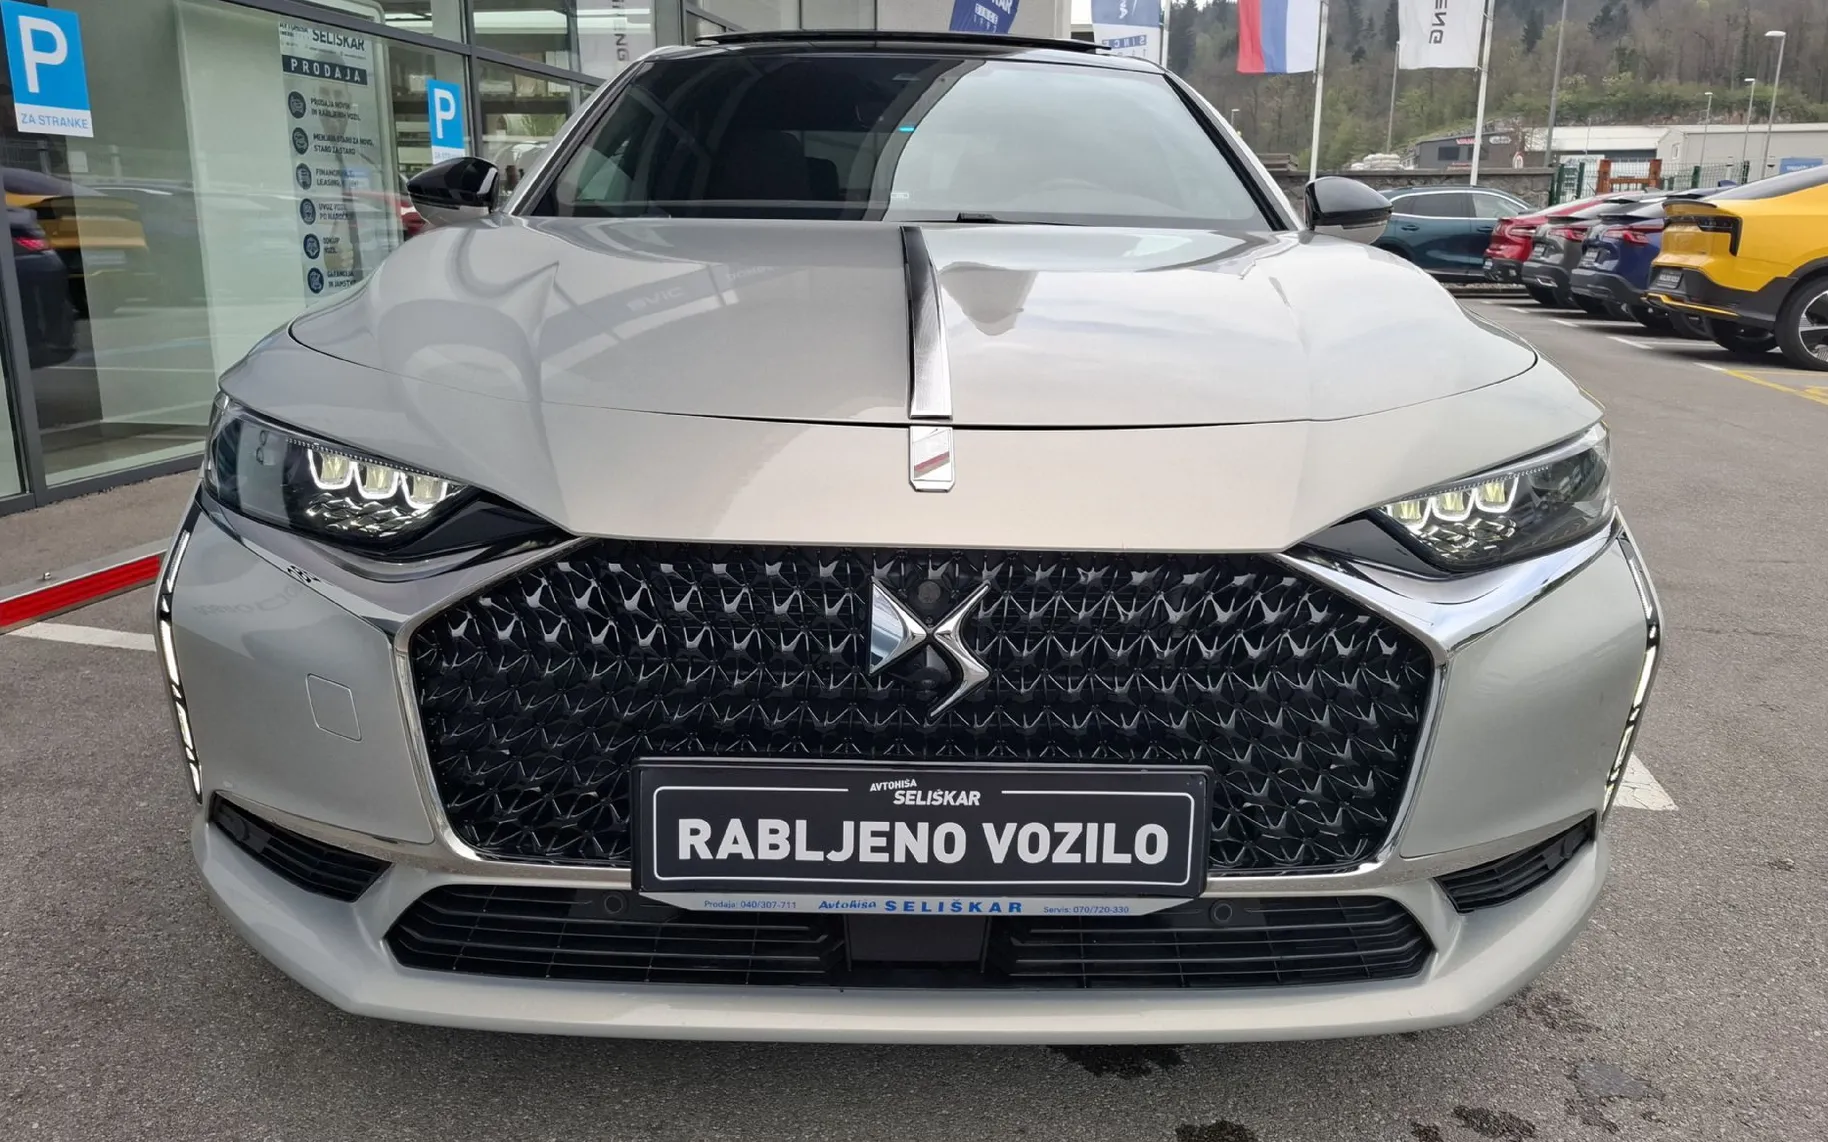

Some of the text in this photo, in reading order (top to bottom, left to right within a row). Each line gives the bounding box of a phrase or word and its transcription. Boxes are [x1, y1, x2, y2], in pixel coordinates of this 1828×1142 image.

[18, 15, 68, 93] P
[290, 58, 361, 83] PRODAJA
[21, 113, 88, 128] ZA STRANKE
[434, 88, 456, 139] P
[869, 779, 918, 792] AVTOHIŠA
[893, 788, 981, 806] SELIŠKAR
[678, 818, 1170, 865] RABLJENO VOZILO
[740, 901, 797, 910] 040/307-711
[884, 898, 1023, 913] SELIŠKAR
[1043, 905, 1130, 914] Servis: 070/720-330
